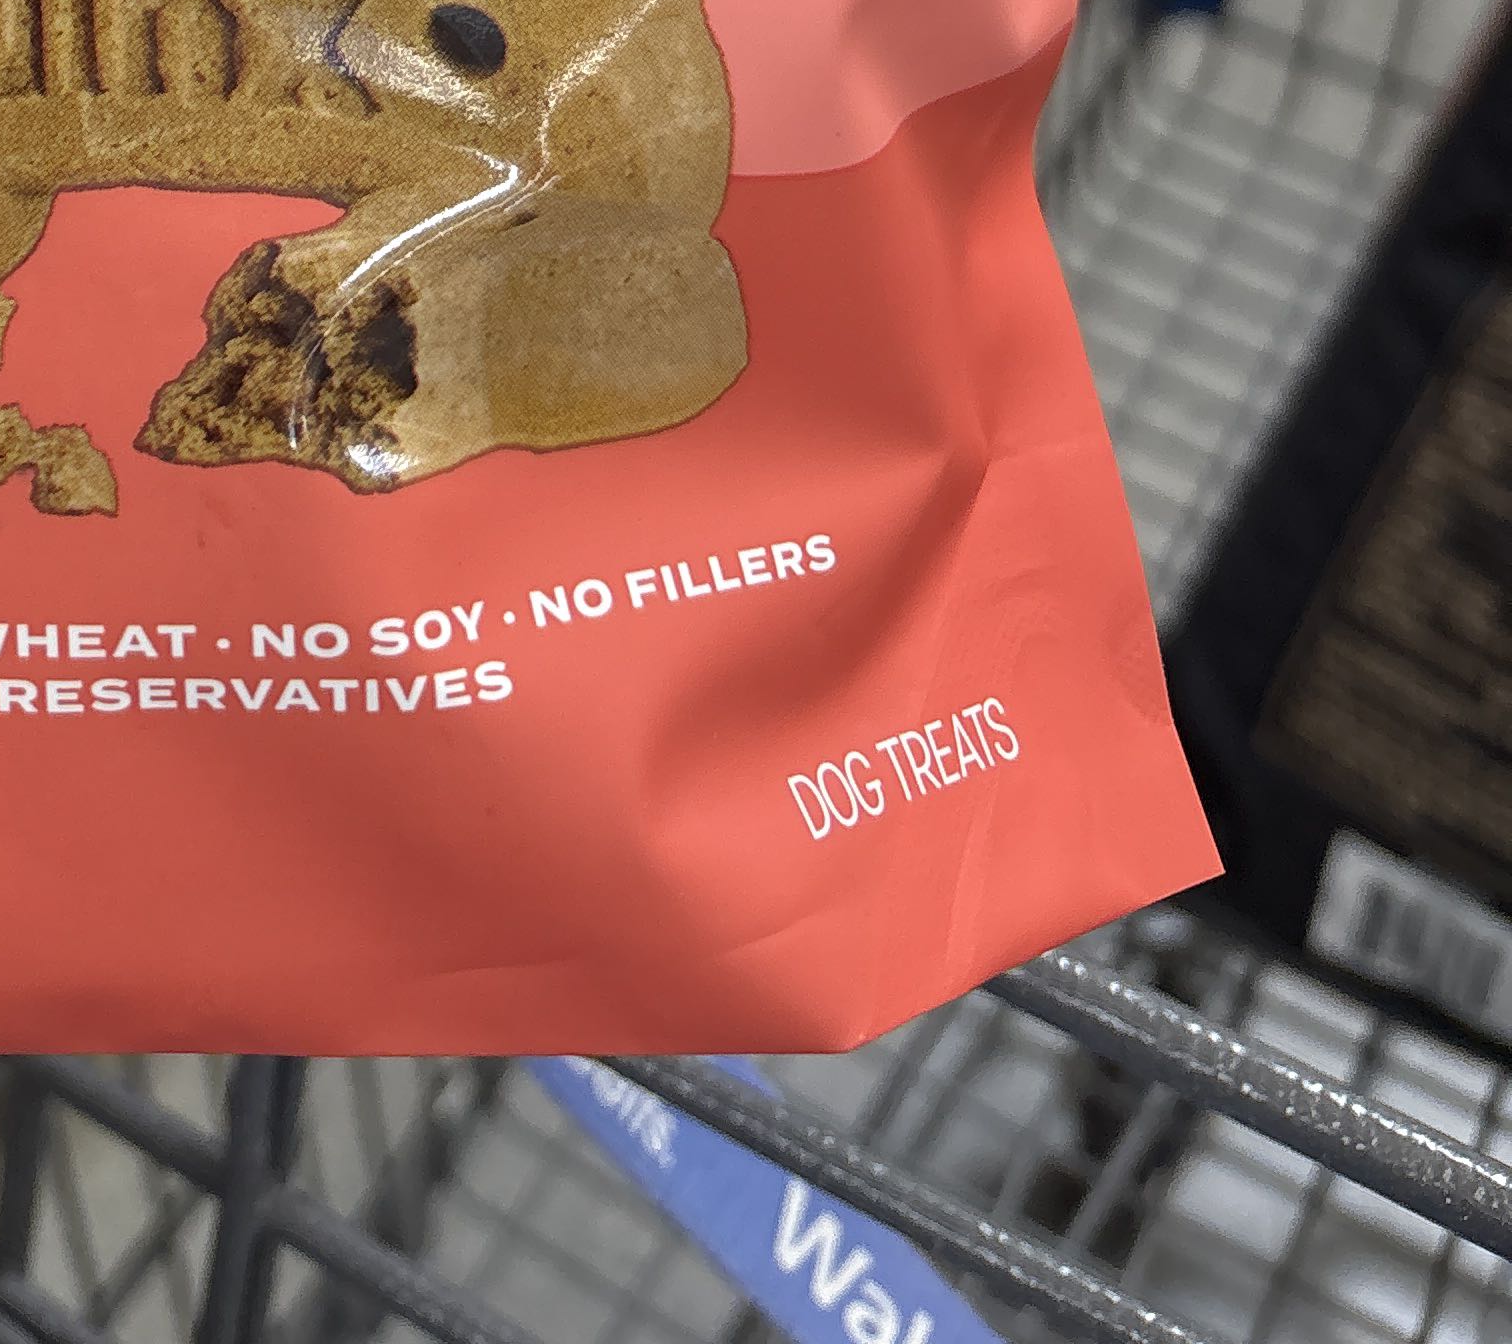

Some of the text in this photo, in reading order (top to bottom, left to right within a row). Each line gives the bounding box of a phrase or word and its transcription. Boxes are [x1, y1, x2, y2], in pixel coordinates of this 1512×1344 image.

[252, 621, 349, 659] NO
[369, 600, 487, 656] SOY
[529, 576, 614, 629] NO
[624, 532, 839, 611] FILLERS
[787, 696, 1020, 841] DOG TREATS
